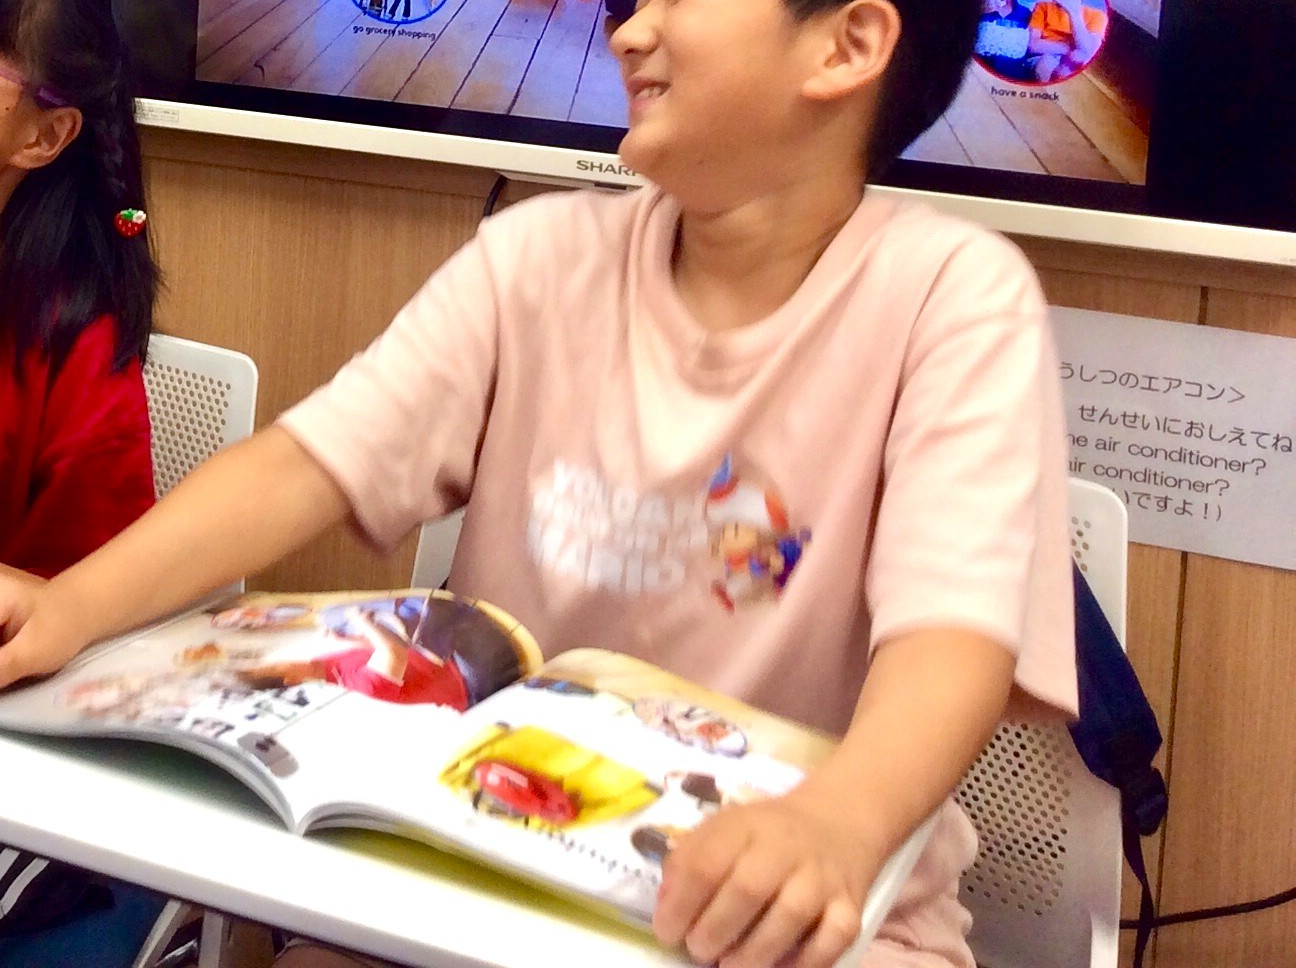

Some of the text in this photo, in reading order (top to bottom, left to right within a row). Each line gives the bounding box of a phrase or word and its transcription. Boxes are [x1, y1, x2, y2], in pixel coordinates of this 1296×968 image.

[353, 25, 436, 41] go grocery shopping
[991, 86, 1017, 97] have
[1029, 91, 1060, 101] snack
[576, 159, 636, 177] SHAR
[1078, 404, 1293, 454] せんせいにおしえてね
[1094, 436, 1121, 454] air
[1127, 441, 1267, 476] conditioner?
[1093, 462, 1231, 497] conditioner?
